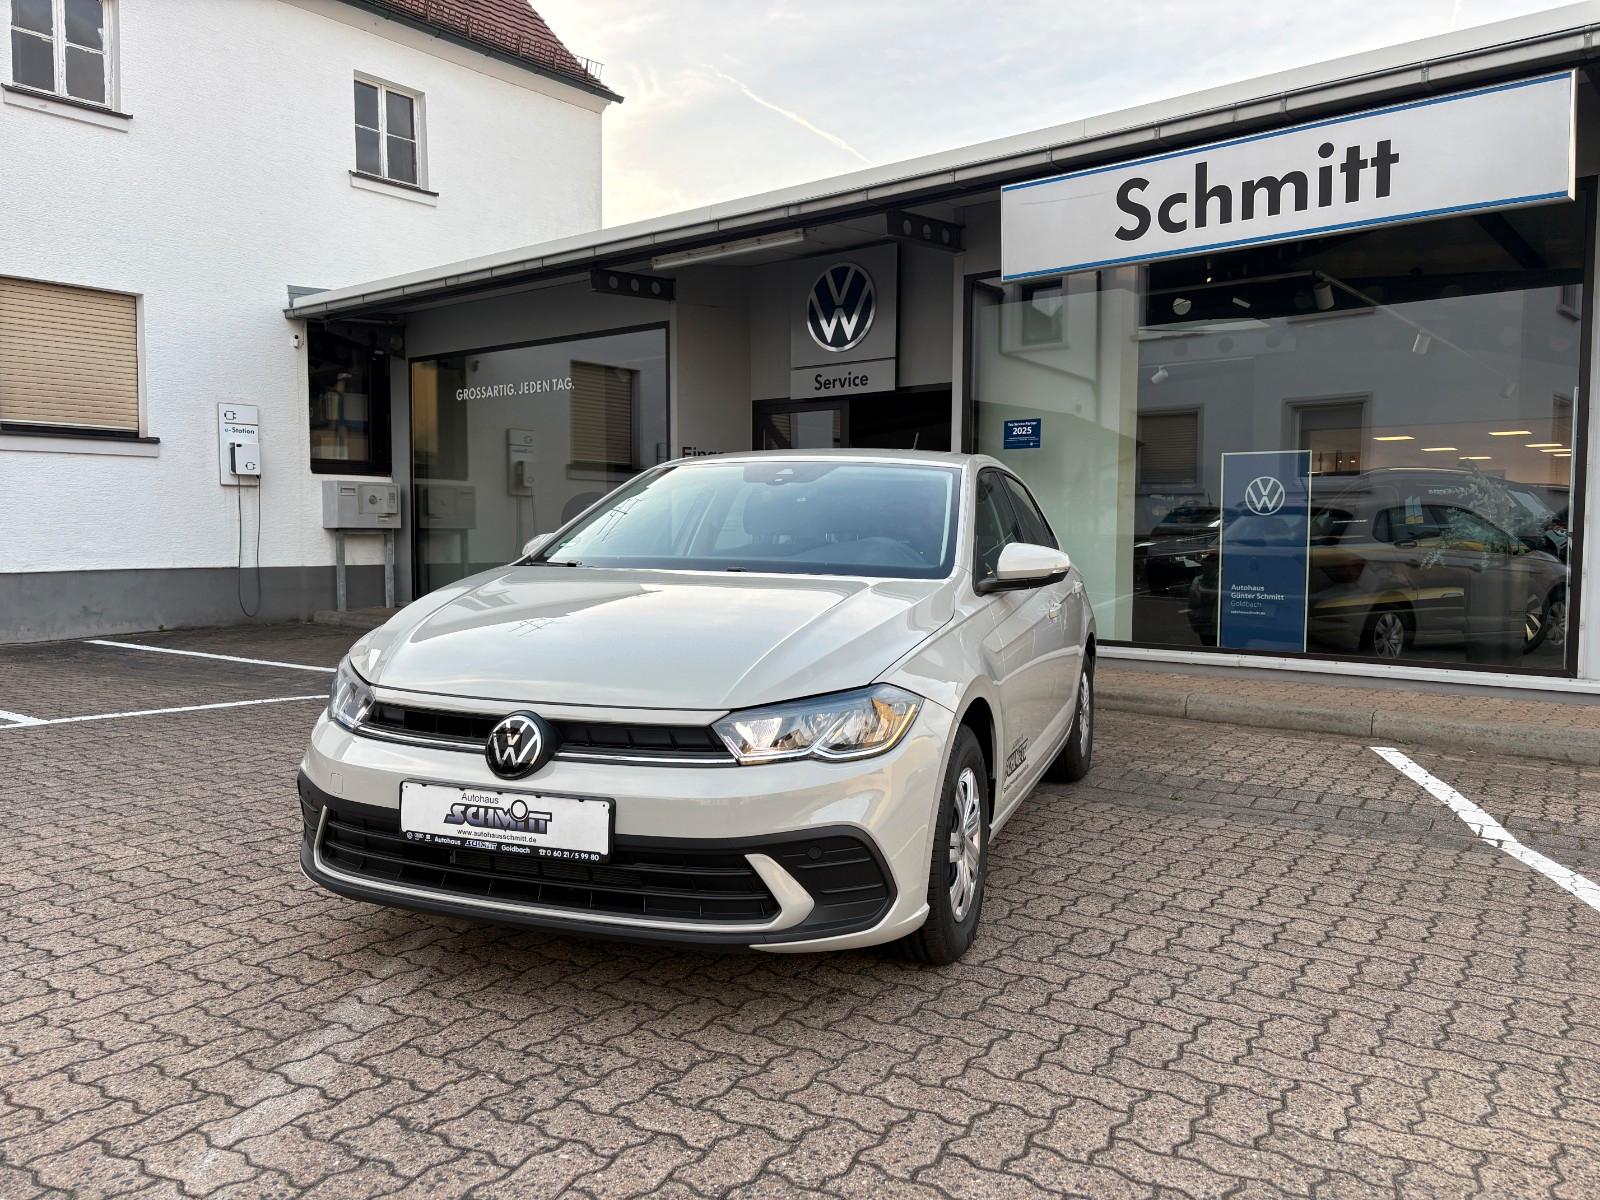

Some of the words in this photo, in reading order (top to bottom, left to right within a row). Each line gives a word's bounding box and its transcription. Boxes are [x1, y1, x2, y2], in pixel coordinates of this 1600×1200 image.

[1115, 139, 1399, 241] Schmitt
[456, 383, 517, 401] GROSSARTIG.
[519, 380, 550, 394] JEDEN
[552, 377, 575, 390] TAG.
[814, 372, 869, 391] Service
[1231, 584, 1265, 592] Autohaus
[1230, 600, 1262, 608] Goldbach
[1256, 592, 1285, 601] Schmitt
[461, 792, 500, 805] Autohaus
[457, 828, 537, 844] www.autohausschmitt.de
[434, 835, 461, 846] Autohaus
[501, 844, 531, 854] Goldbach
[580, 852, 589, 860] 99
[590, 853, 600, 861] 80
